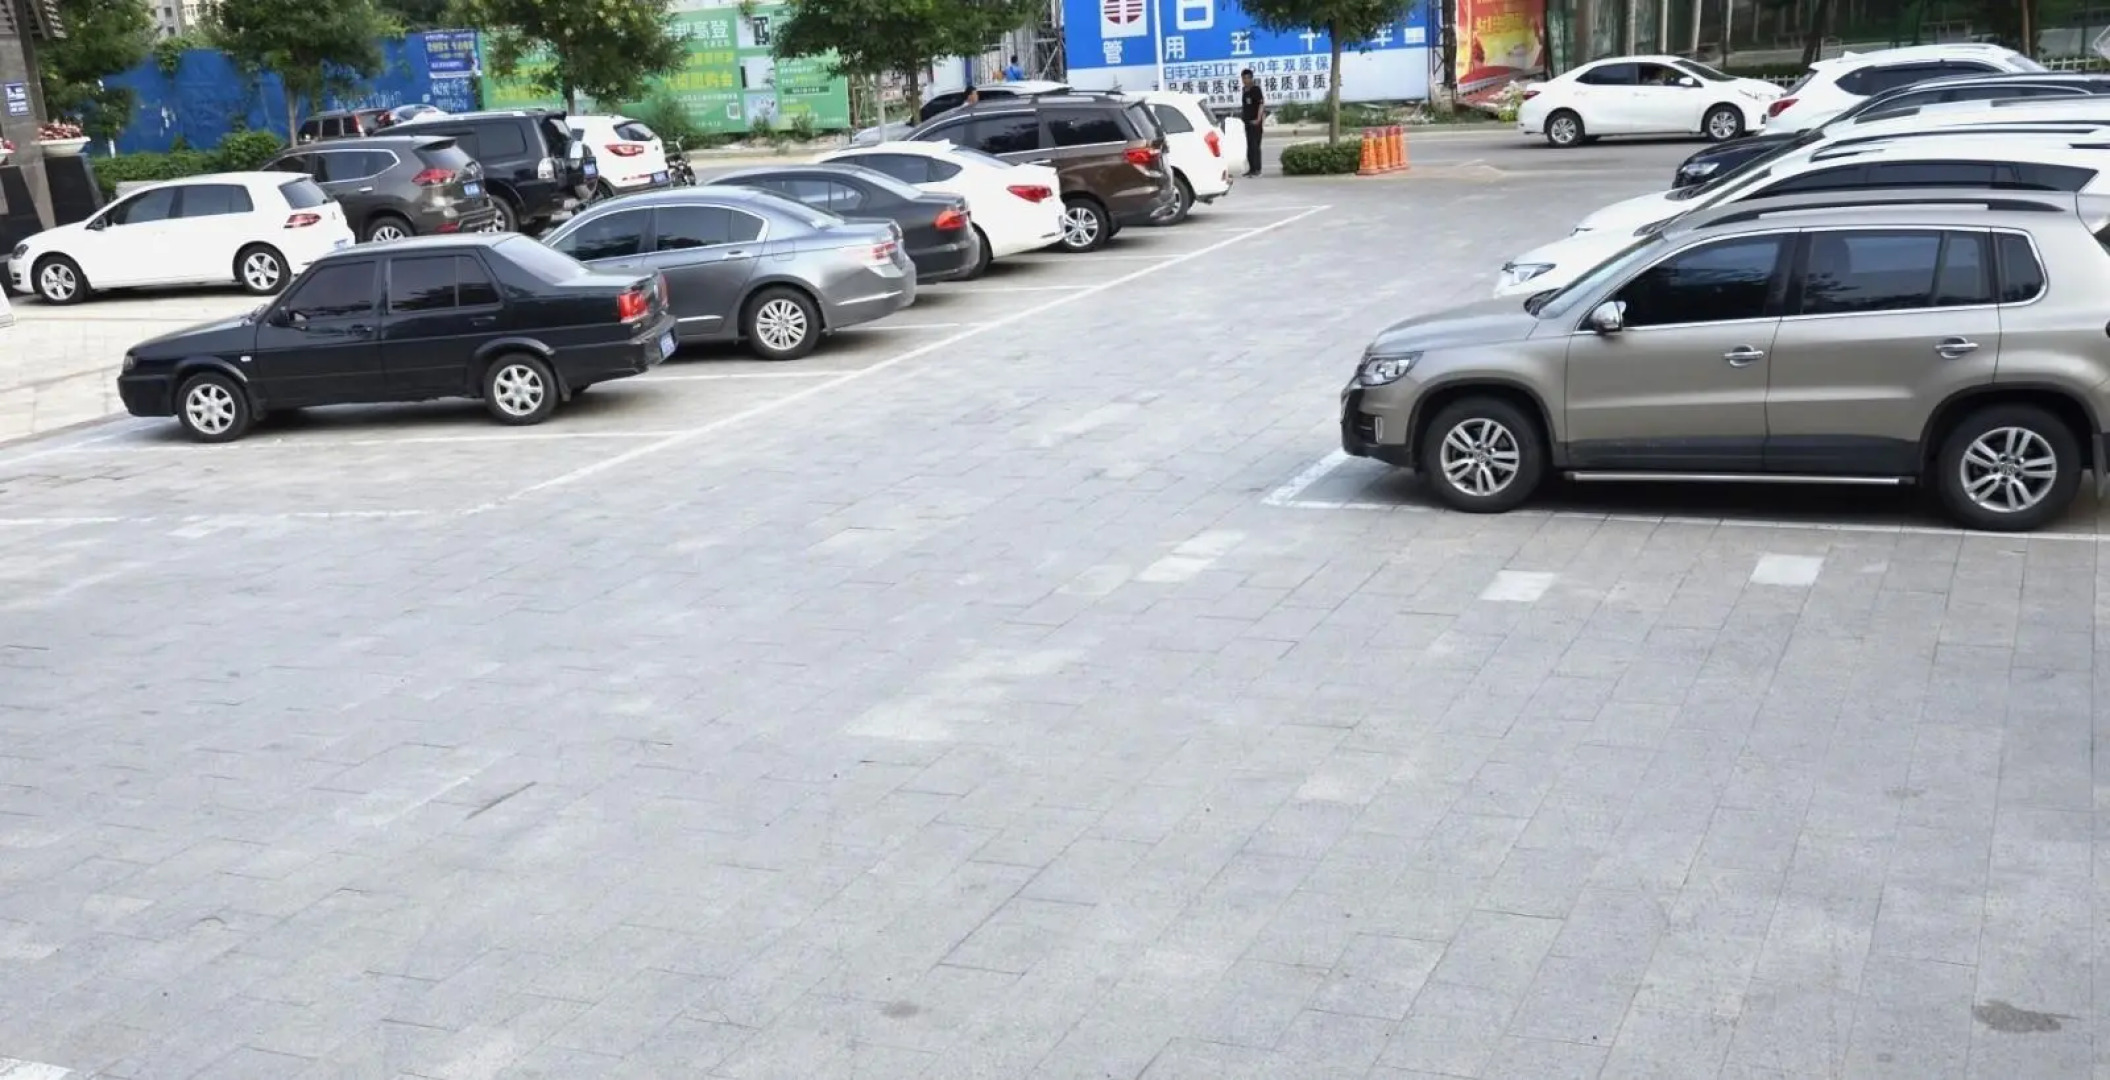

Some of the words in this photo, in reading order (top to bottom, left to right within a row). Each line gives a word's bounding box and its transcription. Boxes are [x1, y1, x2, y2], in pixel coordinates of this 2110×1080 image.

[1164, 62, 1237, 79] 日丰安全卫士
